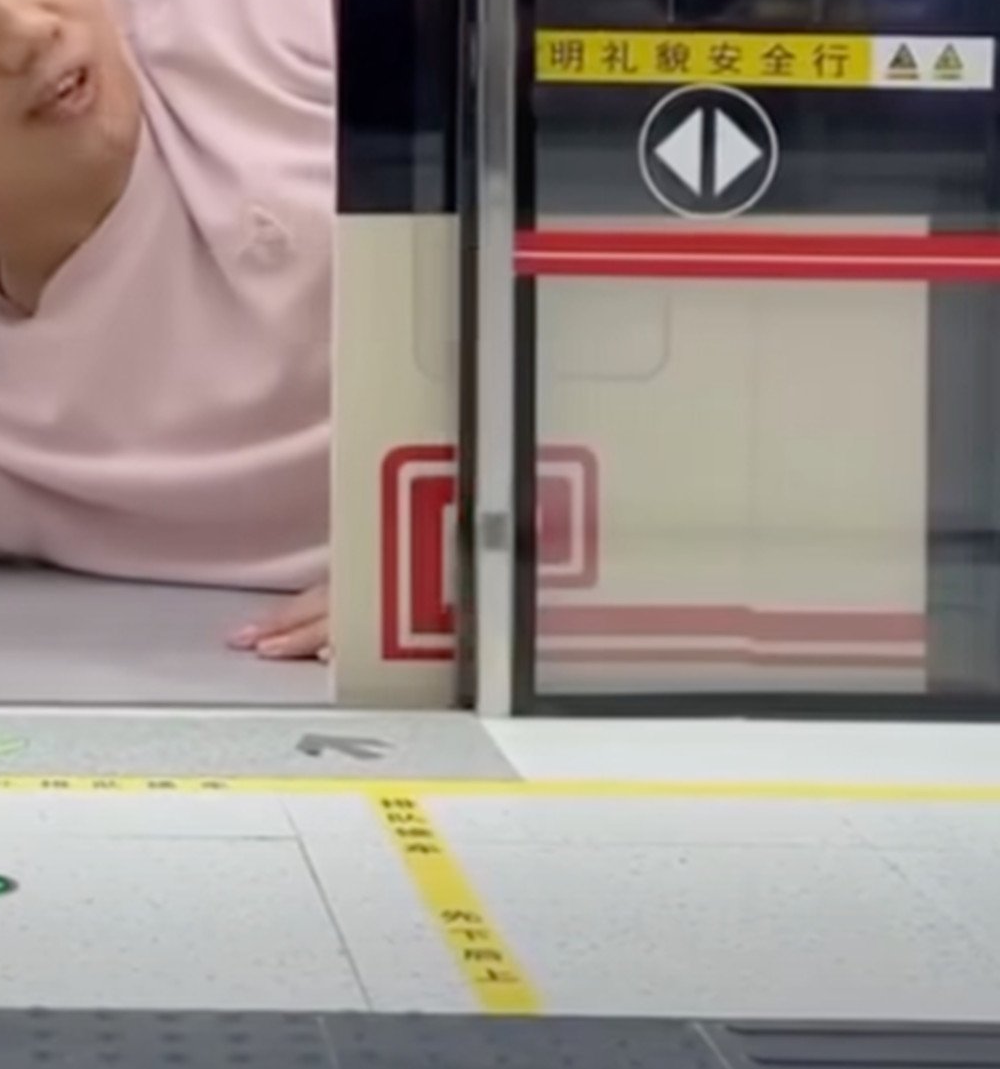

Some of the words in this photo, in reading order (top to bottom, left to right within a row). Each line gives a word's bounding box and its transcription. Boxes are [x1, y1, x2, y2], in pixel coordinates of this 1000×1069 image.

[550, 40, 849, 78] 明礼貌安全行
